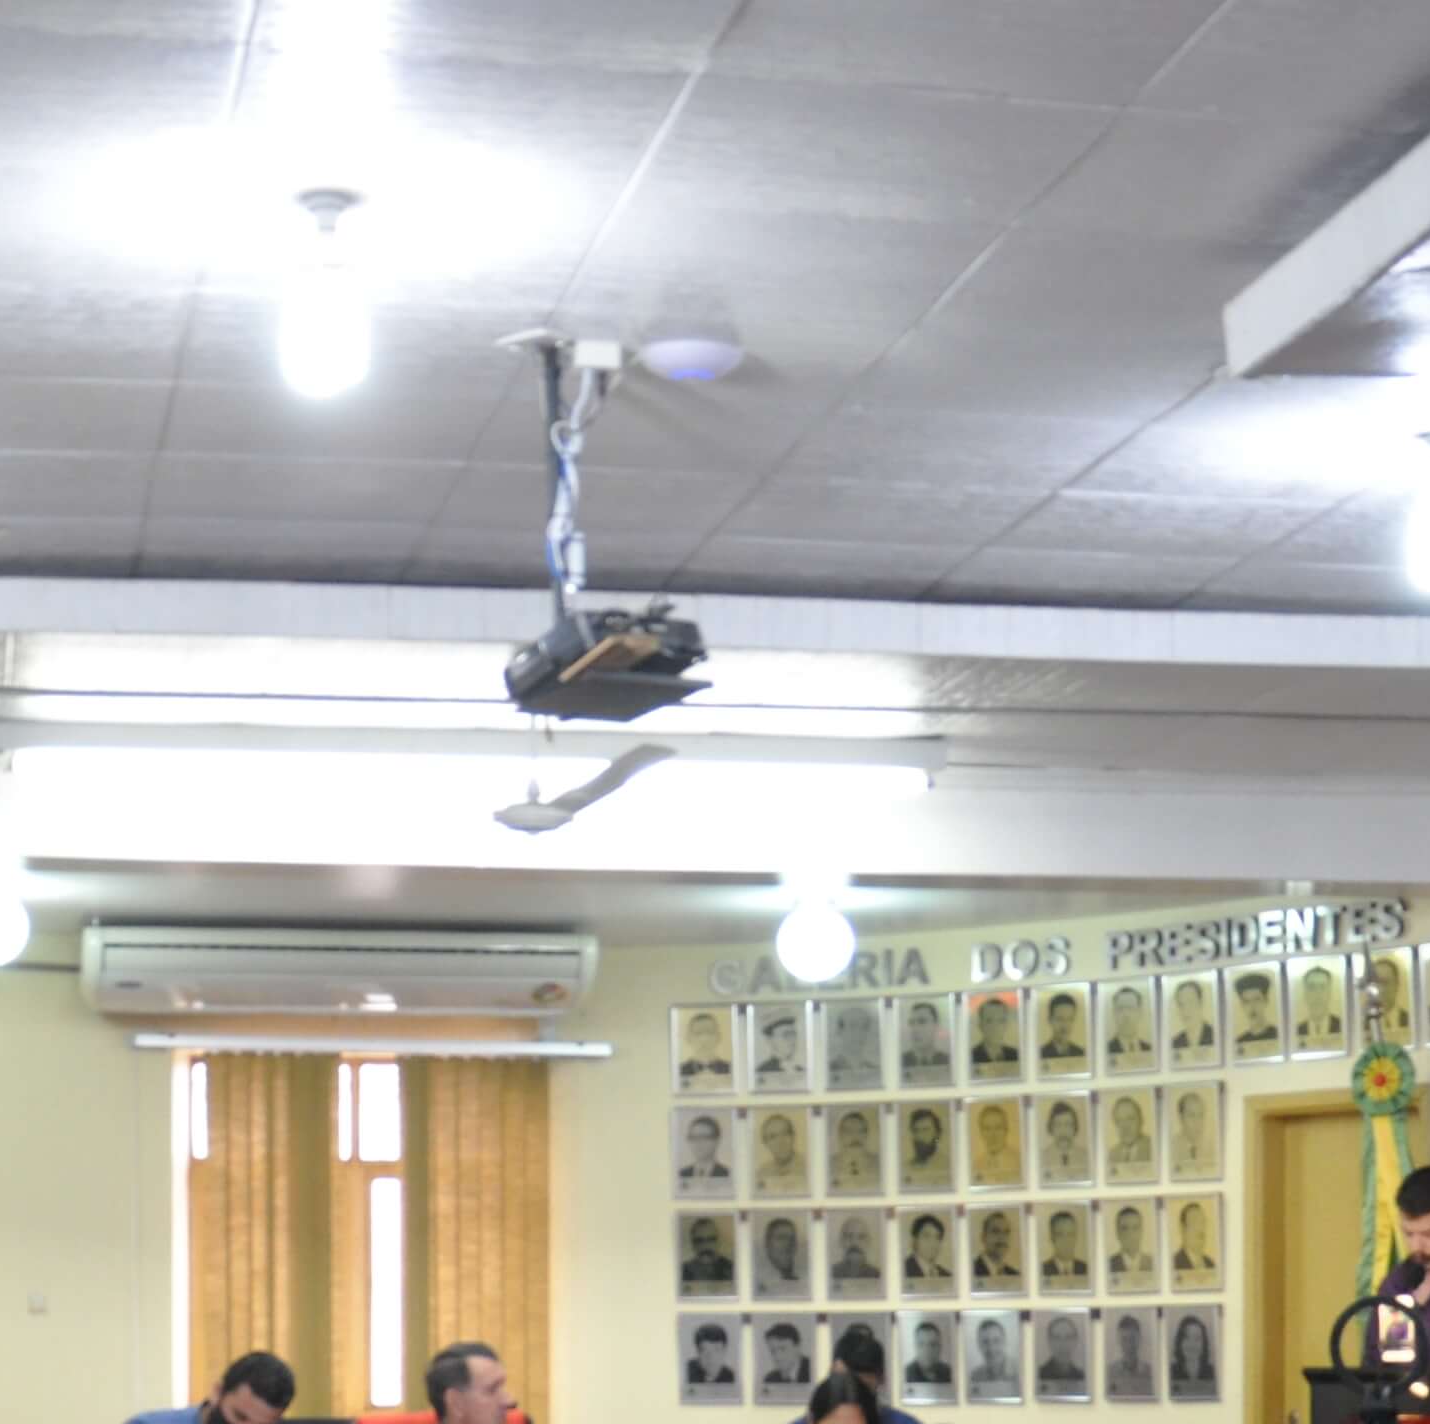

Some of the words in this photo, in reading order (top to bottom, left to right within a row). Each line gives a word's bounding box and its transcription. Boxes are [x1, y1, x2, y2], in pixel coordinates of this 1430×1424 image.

[707, 947, 930, 996] GARIA
[971, 936, 1072, 983] DOS
[1107, 898, 1411, 970] PRESIDENTES
